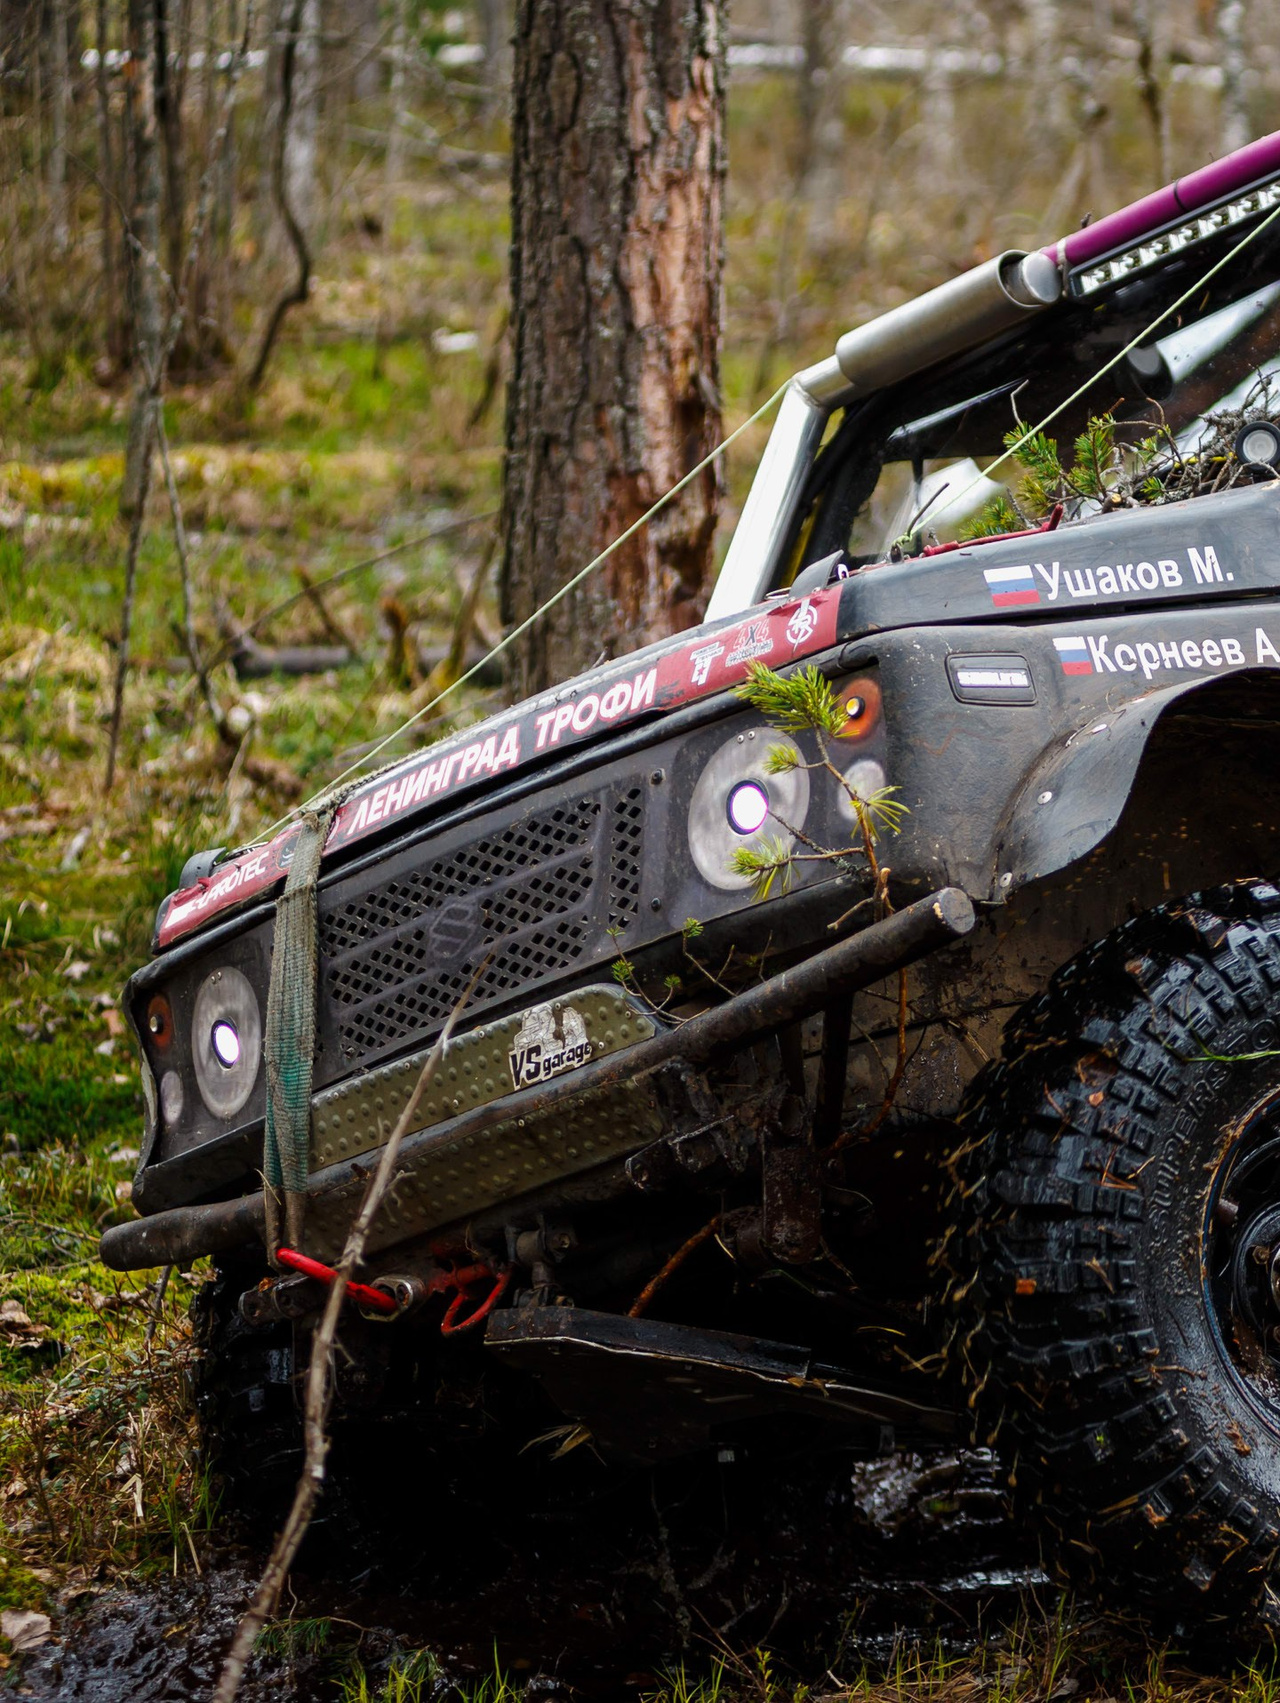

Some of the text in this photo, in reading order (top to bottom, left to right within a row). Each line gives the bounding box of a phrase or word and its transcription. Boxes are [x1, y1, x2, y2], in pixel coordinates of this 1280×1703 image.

[1034, 546, 1234, 600] Ушаков М.
[1087, 635, 1246, 680] Корнеев
[347, 669, 657, 835] ЛЕНИНГРАД ТРОФИ
[510, 1042, 592, 1087] VS garage
